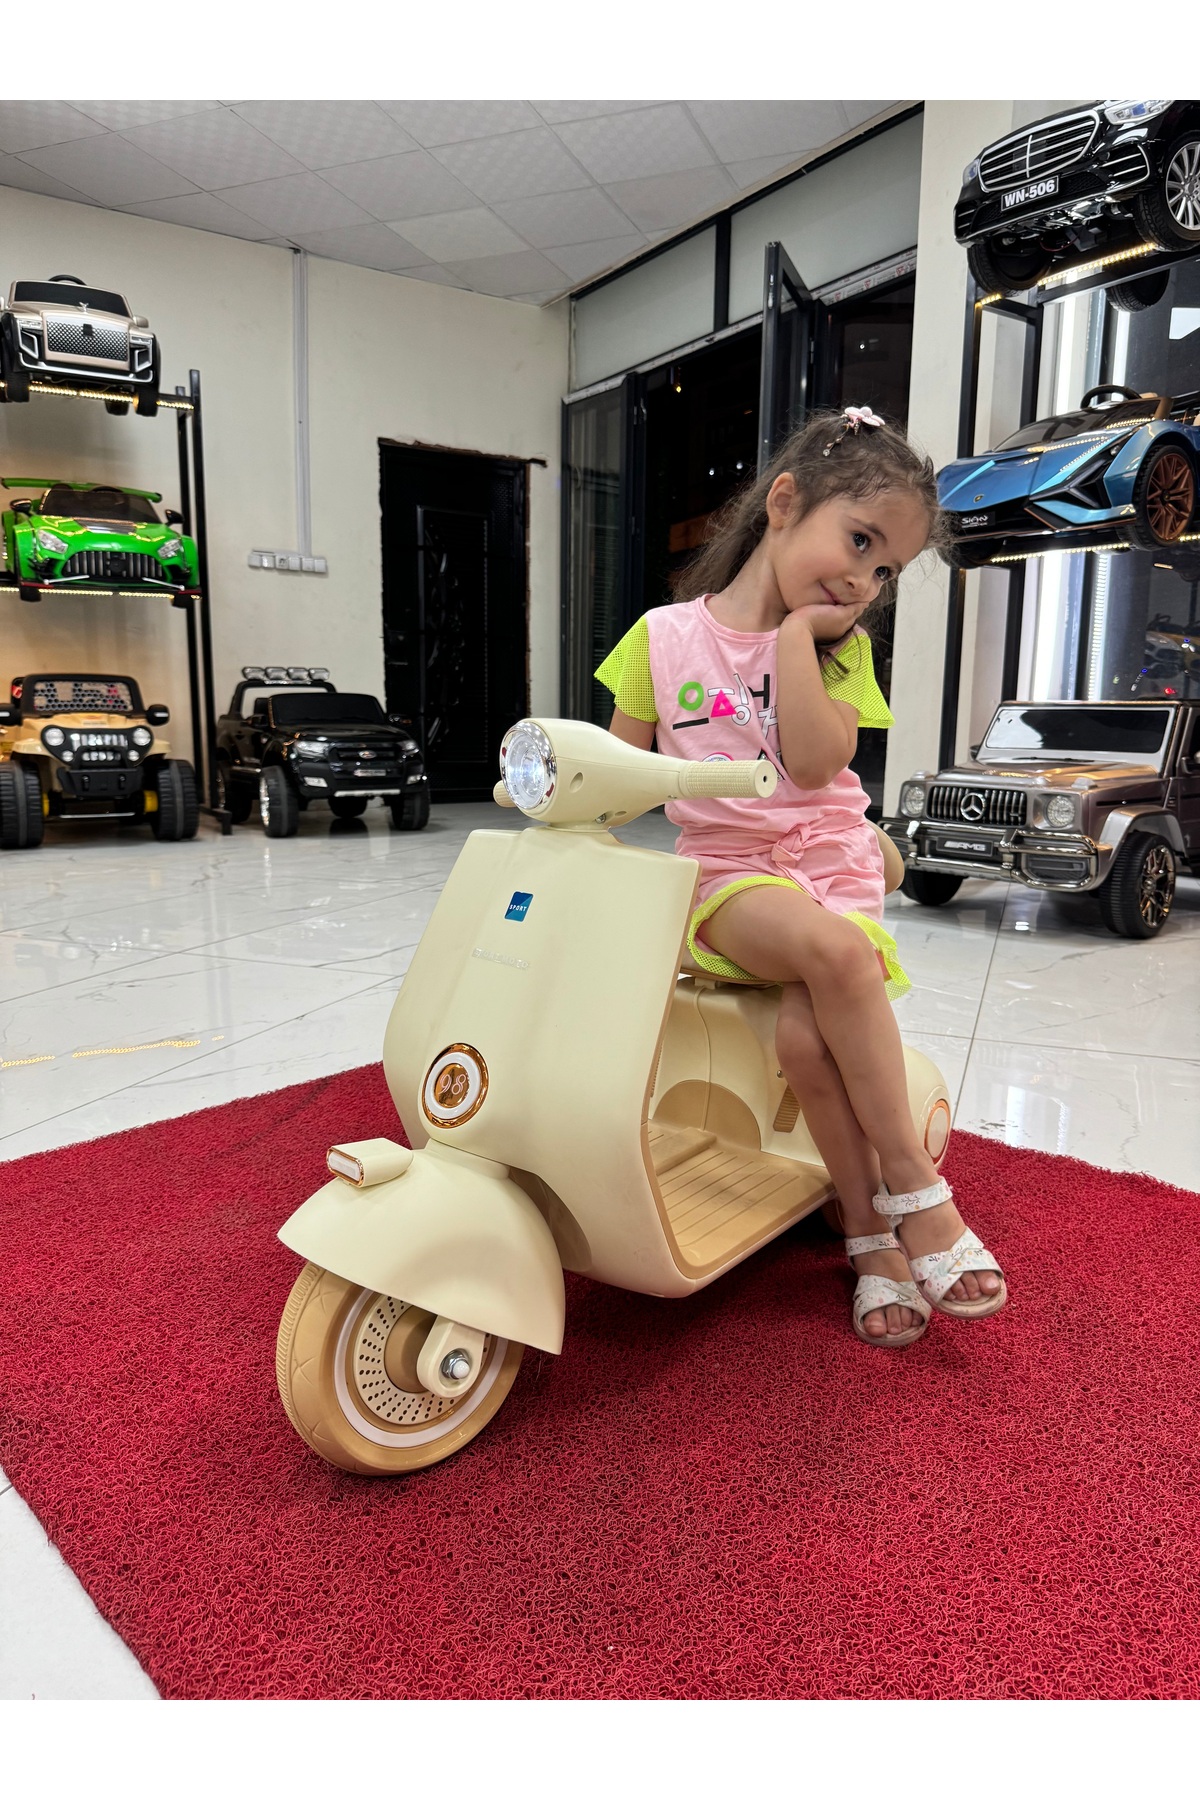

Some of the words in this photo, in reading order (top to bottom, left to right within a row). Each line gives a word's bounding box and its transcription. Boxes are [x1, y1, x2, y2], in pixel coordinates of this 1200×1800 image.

[1004, 179, 1055, 207] WN-506
[956, 841, 986, 852] AMG
[509, 904, 527, 912] SPORT
[438, 1073, 467, 1095] 98
